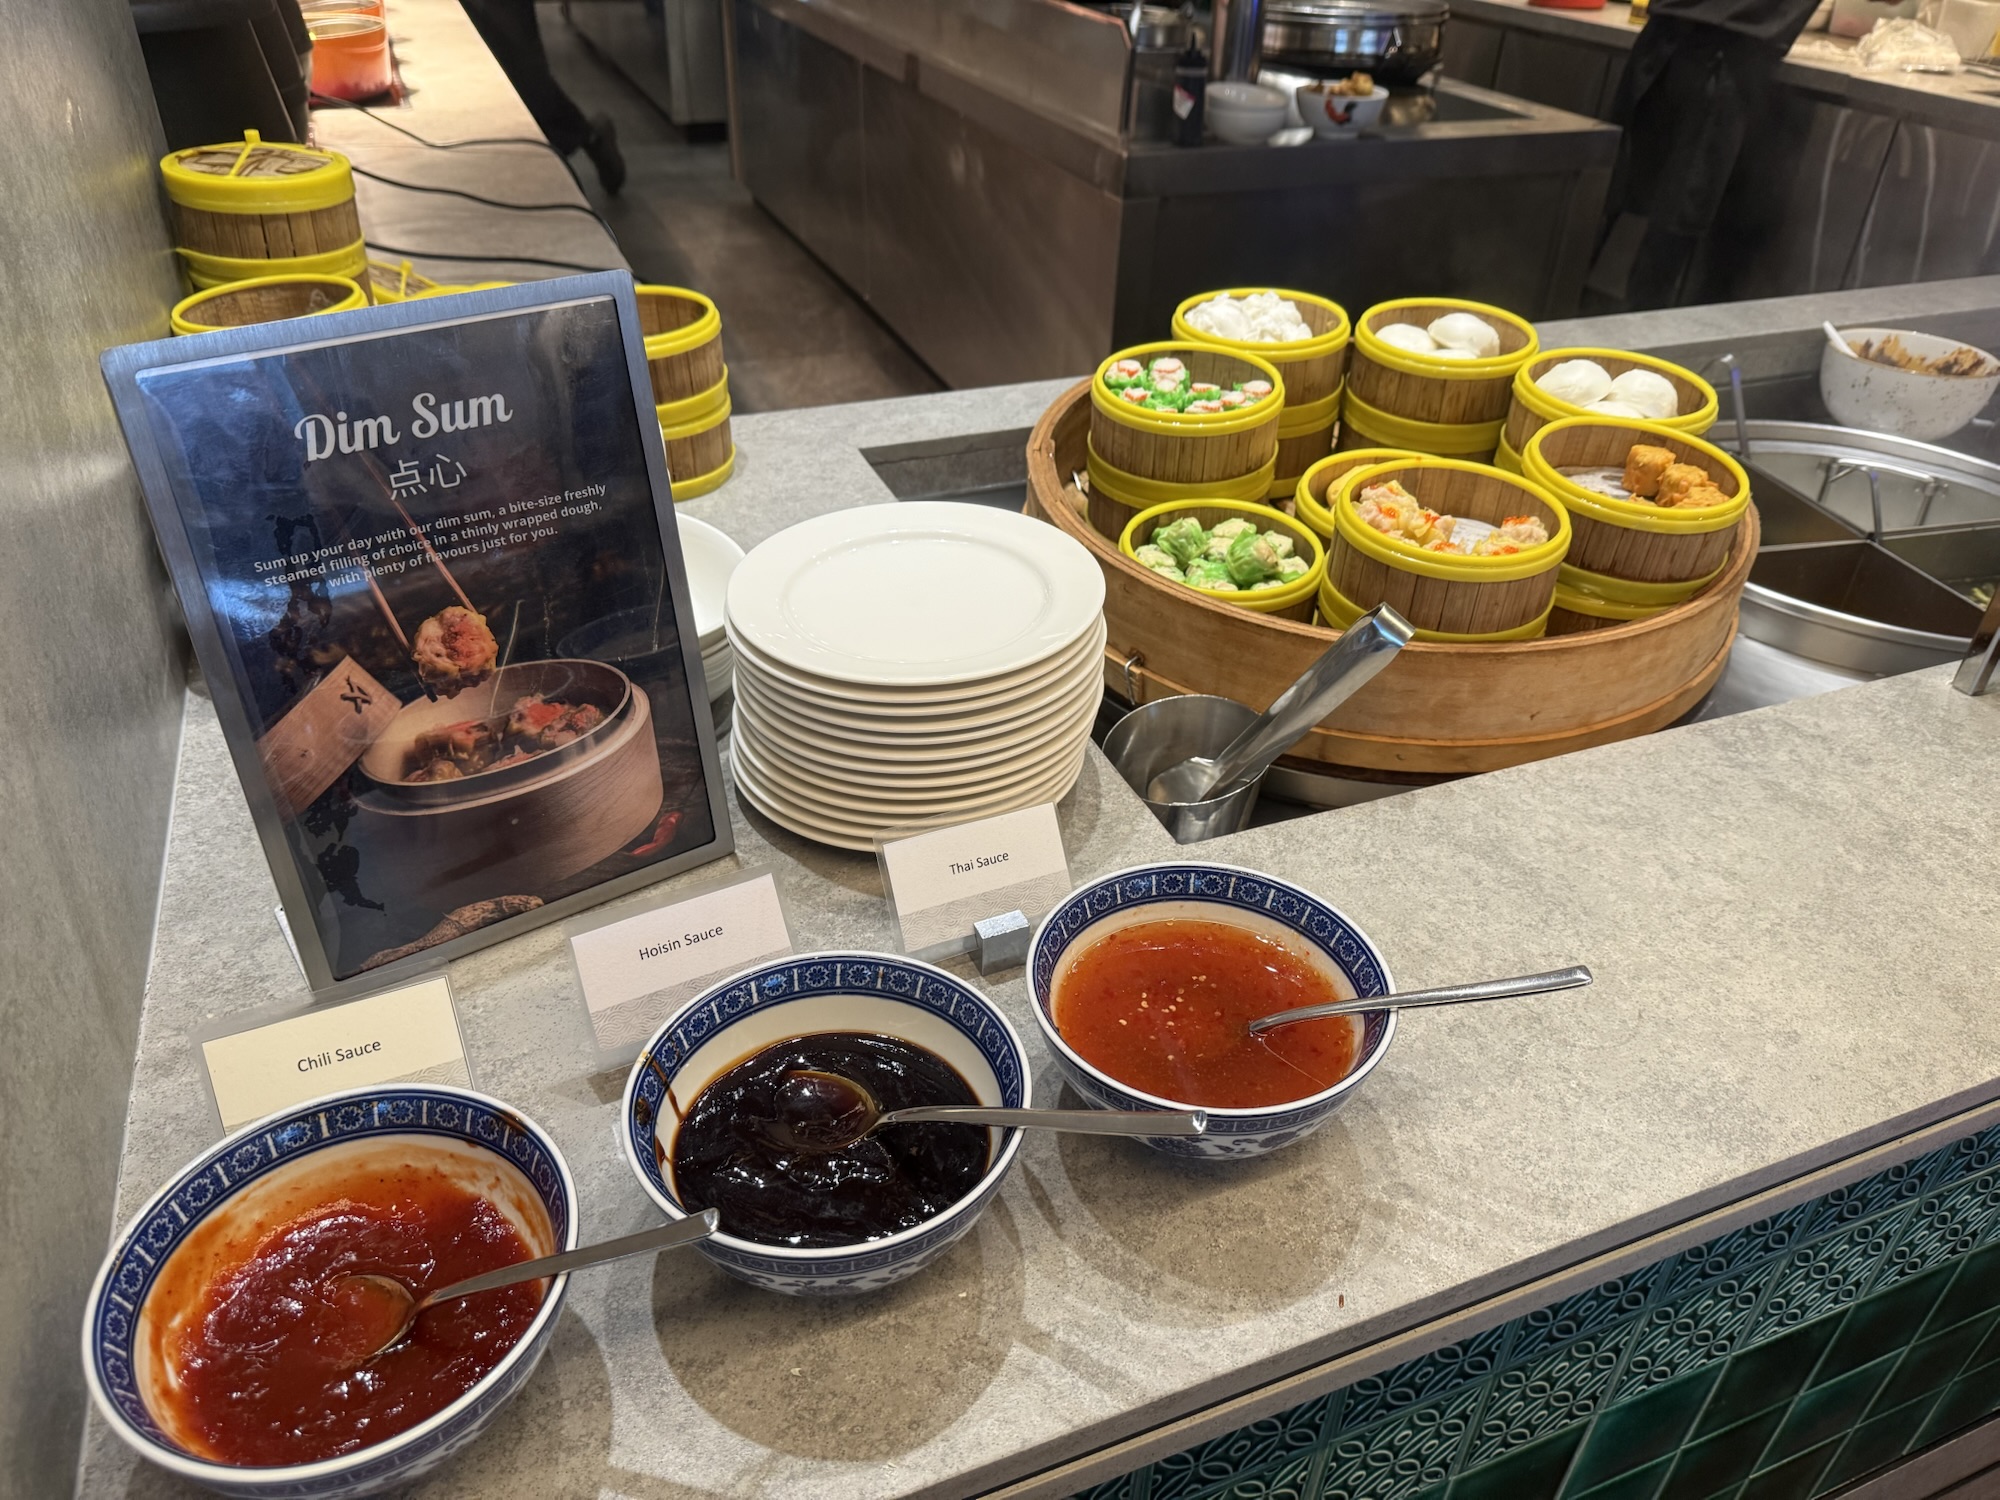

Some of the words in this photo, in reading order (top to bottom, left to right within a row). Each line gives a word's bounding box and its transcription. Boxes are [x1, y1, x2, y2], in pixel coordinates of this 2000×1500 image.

[294, 410, 400, 462] Dim
[411, 392, 513, 439] Sum
[389, 453, 468, 501] 点心
[254, 558, 287, 573] Sum
[290, 554, 309, 568] up
[311, 544, 344, 561] your
[348, 536, 372, 551] day
[375, 528, 406, 544] with
[409, 522, 432, 536] our
[435, 516, 461, 530] dim
[463, 509, 496, 524] sum,
[499, 506, 506, 516] a
[509, 495, 562, 513] bite-size
[564, 484, 606, 501] freshly
[264, 563, 327, 587] steamed
[330, 554, 371, 571] filling
[372, 548, 385, 561] of
[389, 539, 431, 557] choice
[434, 534, 447, 546] in
[451, 533, 458, 542] a
[461, 523, 499, 540] thinly
[502, 509, 558, 530] wrapped
[561, 500, 602, 517] dough,
[329, 571, 360, 587] with
[364, 560, 406, 582] plenty
[409, 554, 423, 567] of
[425, 542, 479, 563] flavours
[481, 536, 507, 553] just
[509, 531, 528, 544] for
[530, 525, 558, 542] you.
[949, 860, 974, 875] Thai
[976, 852, 1009, 868] Sauce
[639, 940, 681, 960] Hoisin
[684, 926, 723, 946] Sauce
[297, 1052, 332, 1072] Chili
[335, 1041, 382, 1062] Sauce
